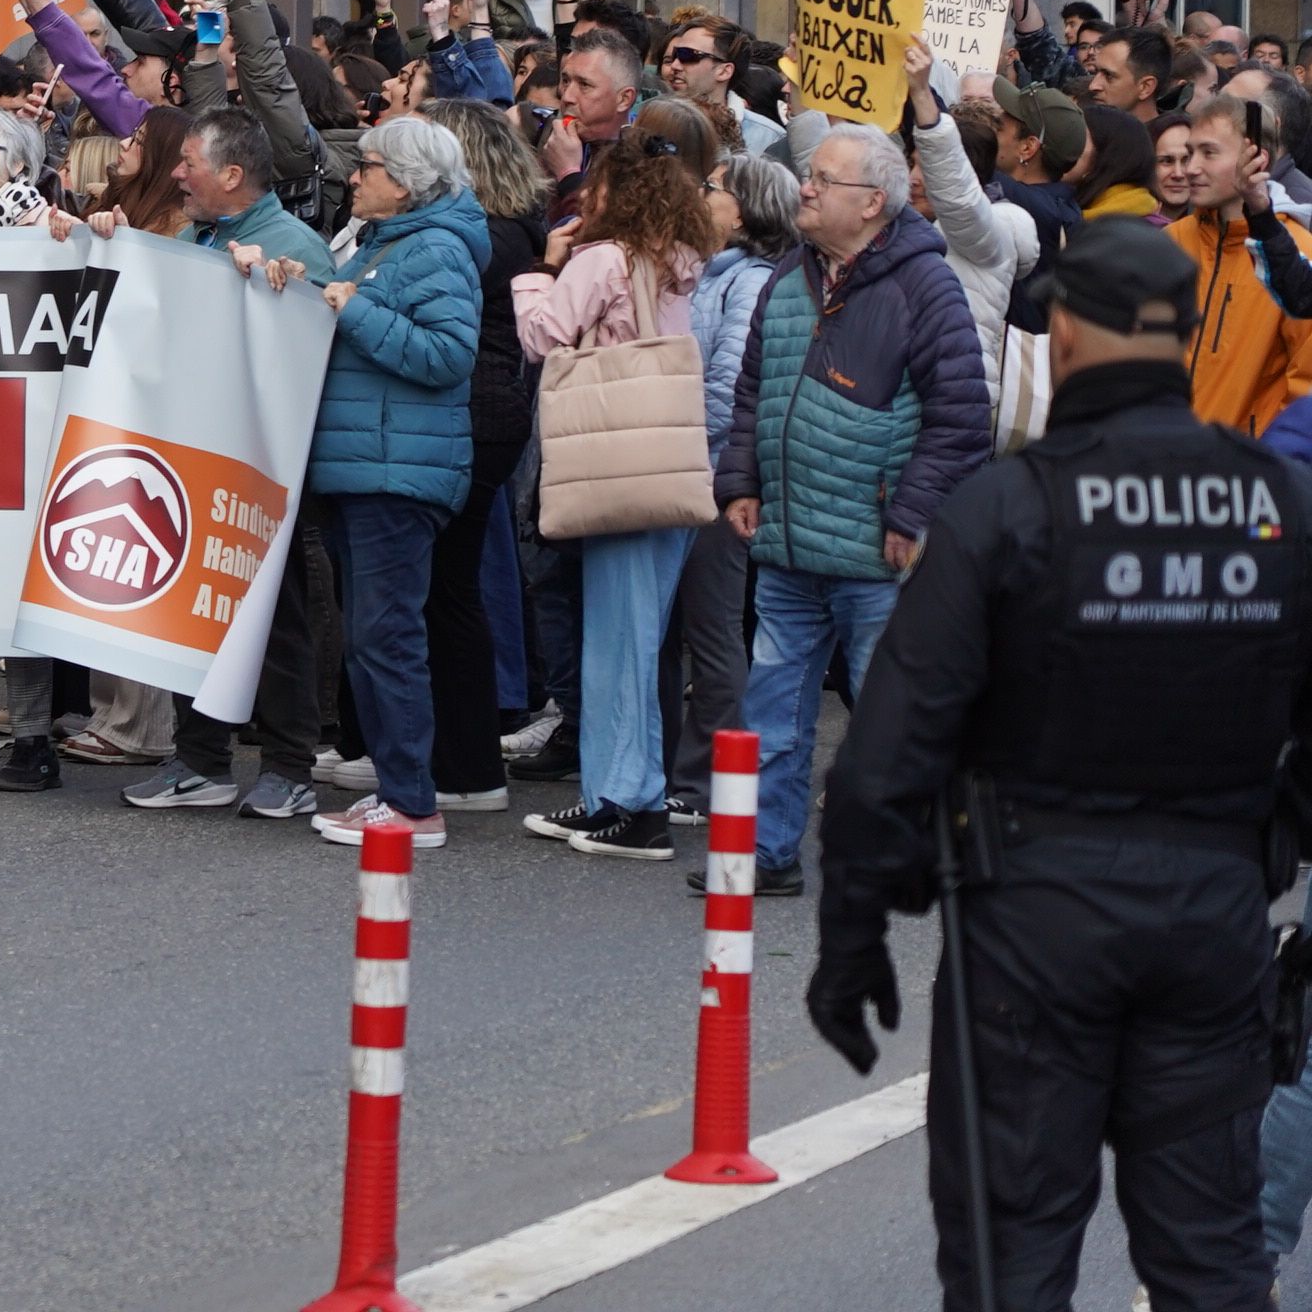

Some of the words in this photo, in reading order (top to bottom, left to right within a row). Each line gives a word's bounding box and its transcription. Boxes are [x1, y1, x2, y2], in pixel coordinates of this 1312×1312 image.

[802, 12, 886, 66] BAIXEN
[959, 36, 981, 55] LA
[210, 486, 283, 543] Sindica
[1075, 474, 1282, 527] POLICIA
[64, 526, 150, 590] SHA
[202, 534, 264, 582] Habit
[1104, 551, 1143, 598] G
[1161, 552, 1203, 598] M
[1220, 552, 1259, 597] O
[1081, 600, 1117, 622] GRUP
[1118, 600, 1209, 622] MANTENIMENT
[1210, 600, 1228, 622] DE
